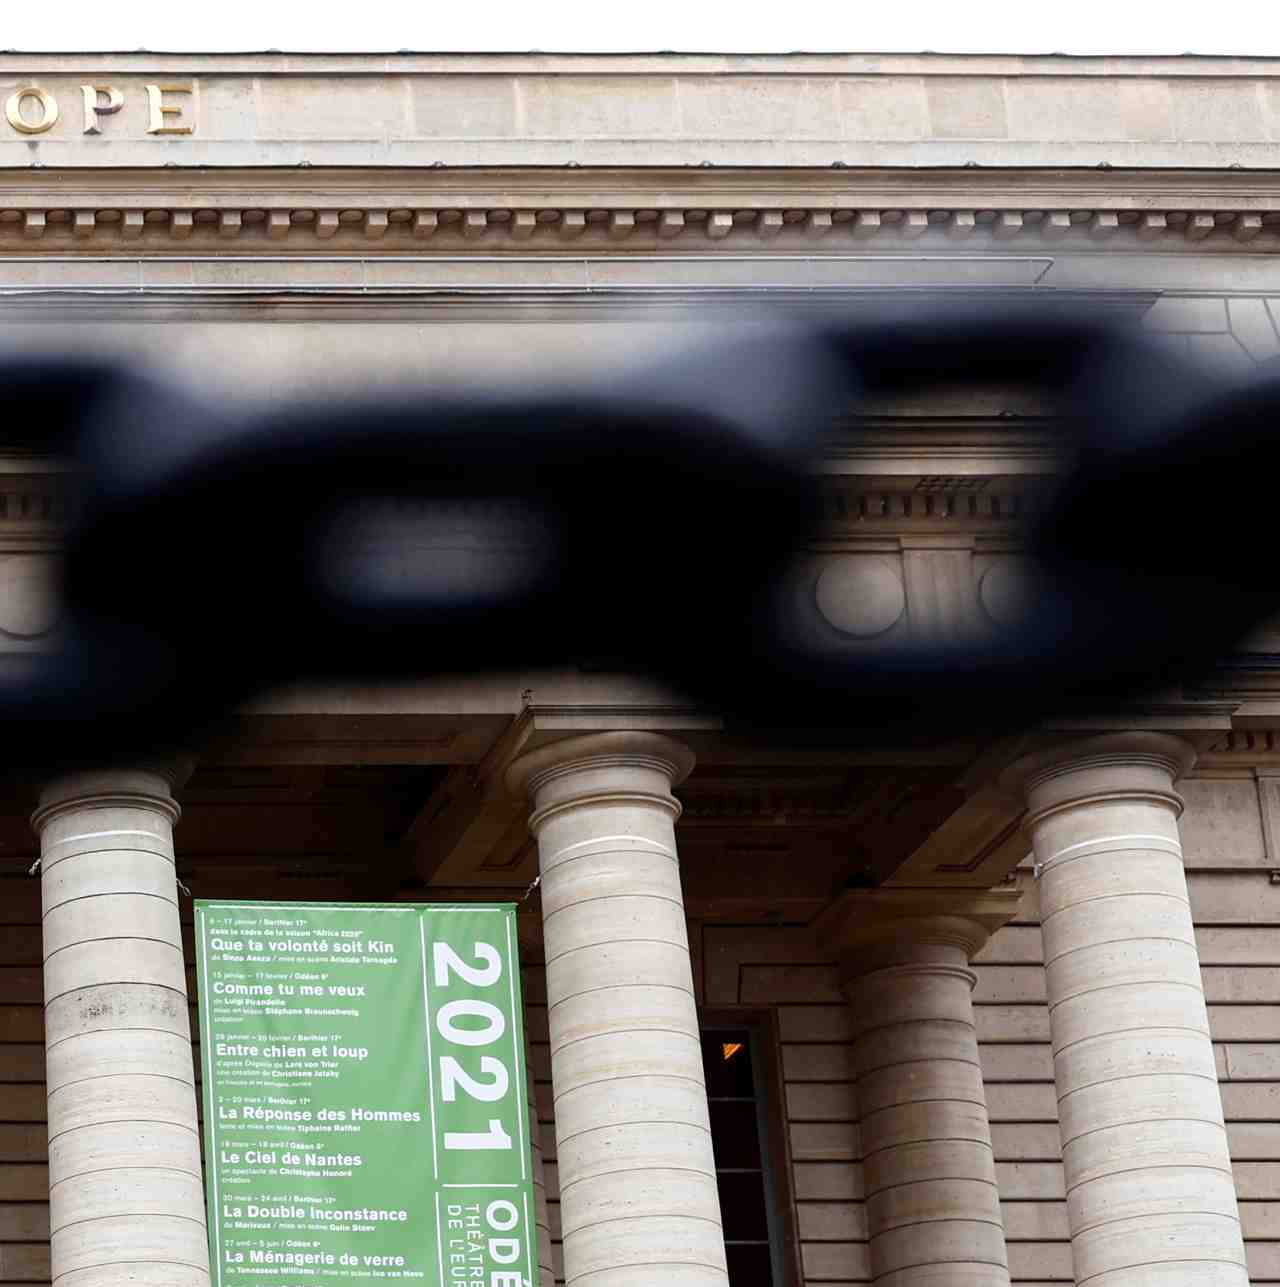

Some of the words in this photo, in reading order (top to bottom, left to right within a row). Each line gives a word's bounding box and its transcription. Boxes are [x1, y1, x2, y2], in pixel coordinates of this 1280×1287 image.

[211, 938, 243, 951] Que
[248, 940, 263, 951] ta
[268, 939, 328, 952] volonté
[333, 941, 362, 952] soit
[368, 941, 394, 952] Kin
[213, 982, 273, 995] Comme
[278, 984, 294, 995] tu
[300, 985, 323, 995] me
[328, 986, 365, 996] veux
[216, 1044, 258, 1056] Entre
[263, 1045, 306, 1057] chien
[312, 1046, 327, 1057] et
[333, 1046, 368, 1060] loup
[433, 942, 512, 1149] 2021
[219, 1107, 238, 1119] La
[243, 1107, 312, 1121] Réponse
[318, 1109, 345, 1120] des
[352, 1109, 420, 1122] Hommes
[221, 1151, 239, 1163] Le
[245, 1151, 276, 1164] Ciel
[282, 1152, 301, 1164] de
[305, 1154, 362, 1166] Nantes
[224, 1205, 241, 1217] La
[248, 1206, 305, 1218] Double
[311, 1207, 407, 1220] Inconstance
[448, 1204, 463, 1229] DE
[225, 1251, 243, 1263] La
[250, 1251, 335, 1266] Ménagerie
[340, 1253, 358, 1265] de
[364, 1255, 404, 1266] verre
